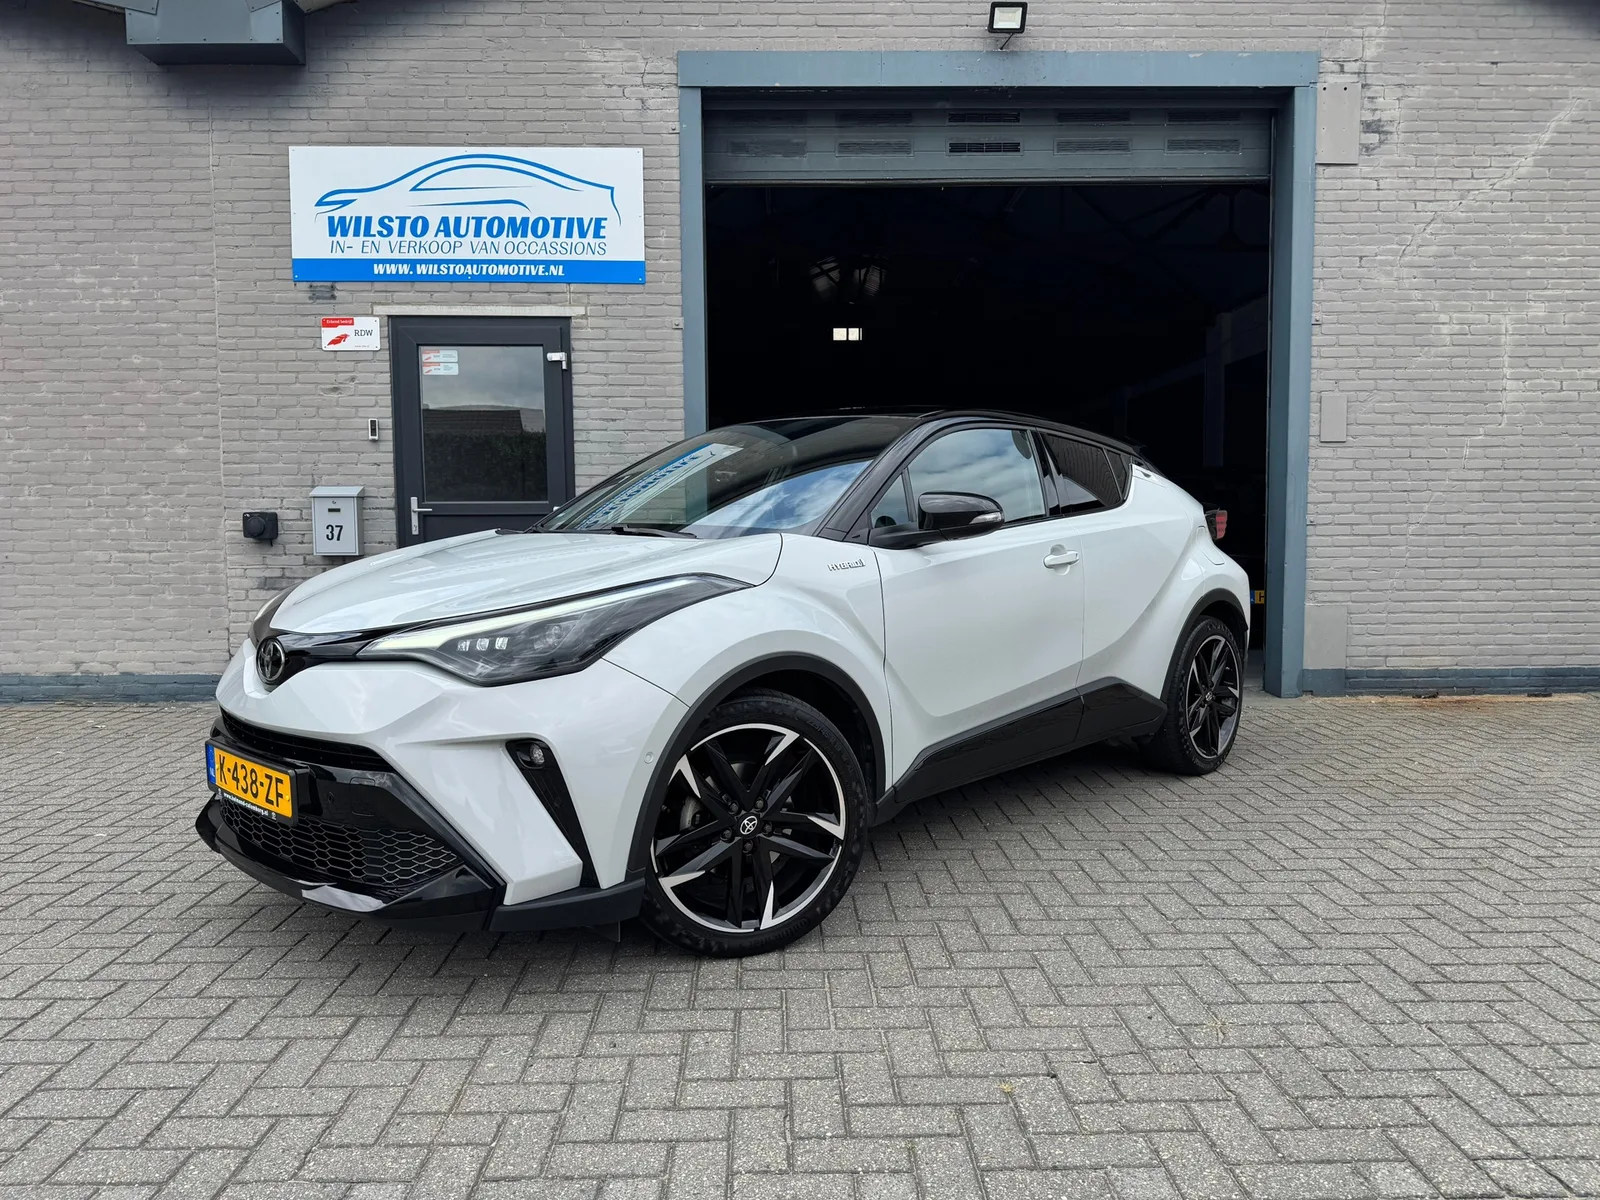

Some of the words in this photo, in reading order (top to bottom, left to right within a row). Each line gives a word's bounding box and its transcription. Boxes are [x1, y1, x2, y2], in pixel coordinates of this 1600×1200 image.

[327, 215, 430, 238] WILSTO
[434, 216, 608, 239] AUTOMOTIVE
[330, 239, 354, 254] IN-
[361, 240, 381, 254] EN
[388, 240, 463, 255] VERKOOP
[469, 241, 501, 255] VAN
[503, 241, 607, 256] OCCASSIONS
[354, 329, 374, 337] RDW
[325, 524, 344, 542] 37
[218, 754, 284, 808] K-438-ZF
